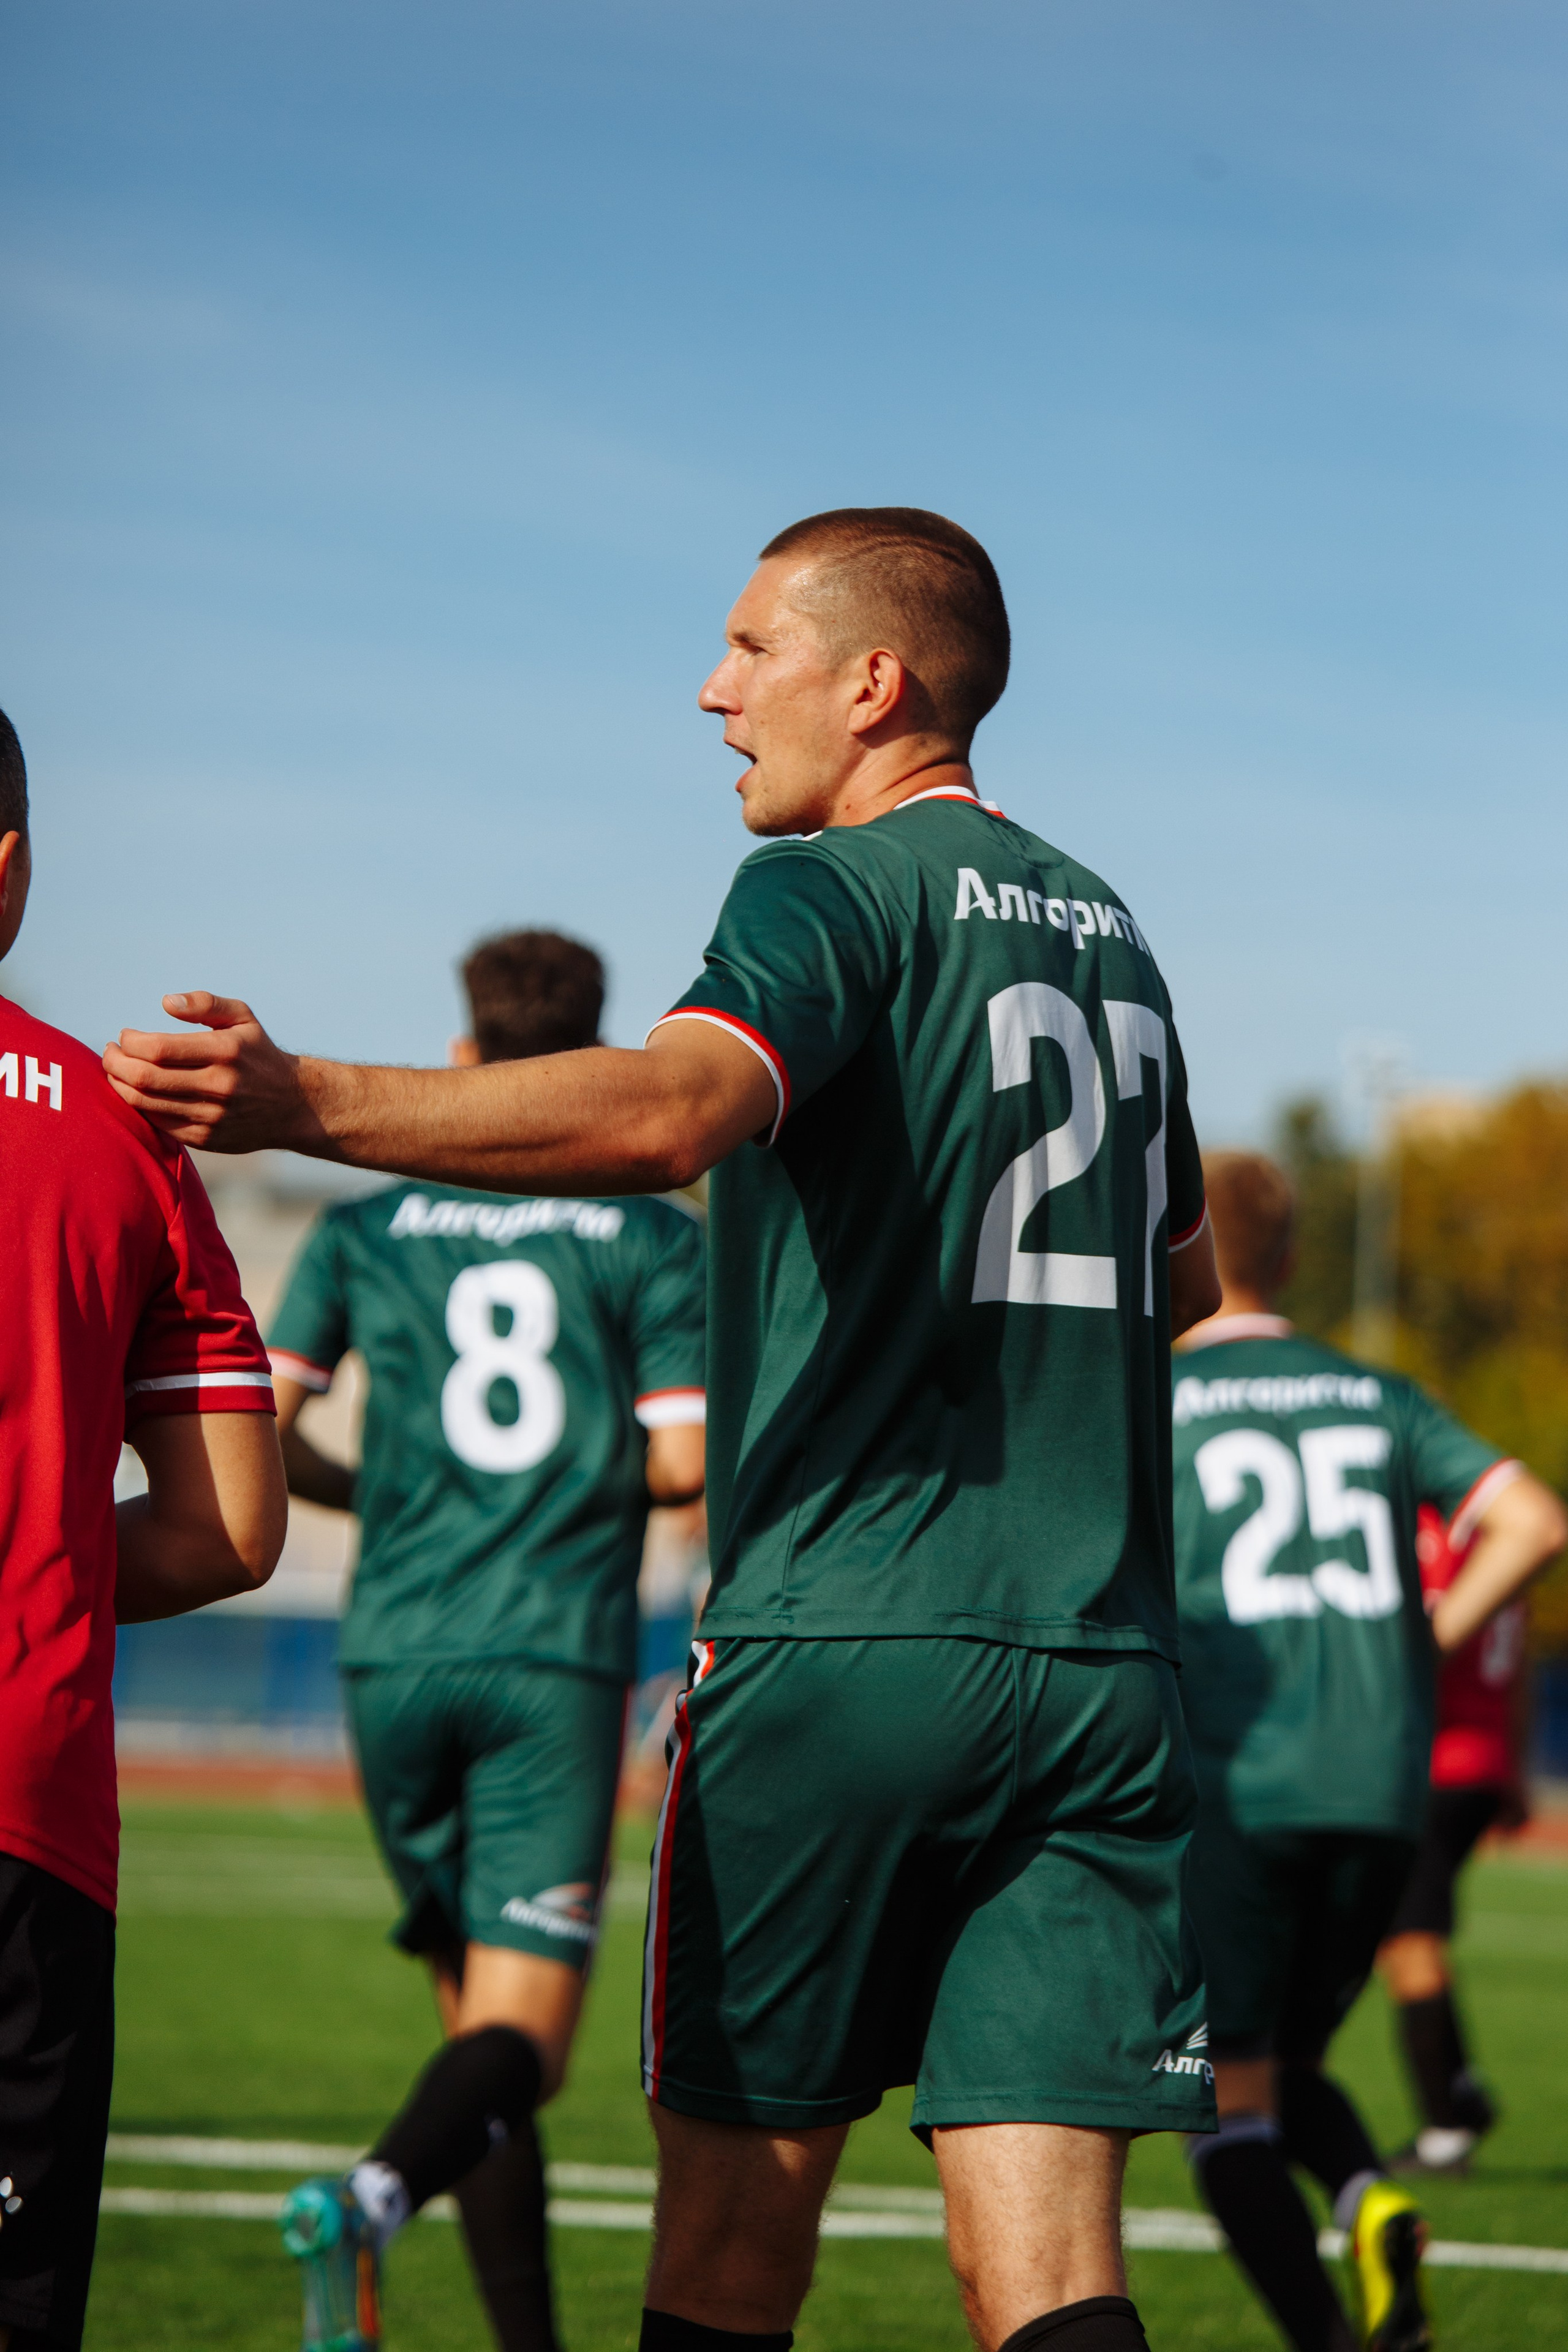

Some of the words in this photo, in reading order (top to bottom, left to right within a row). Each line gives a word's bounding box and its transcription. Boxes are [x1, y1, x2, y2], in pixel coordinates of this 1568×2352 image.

[972, 982, 1167, 1317] 27
[441, 1259, 566, 1474] 8
[1194, 1424, 1402, 1625] 25
